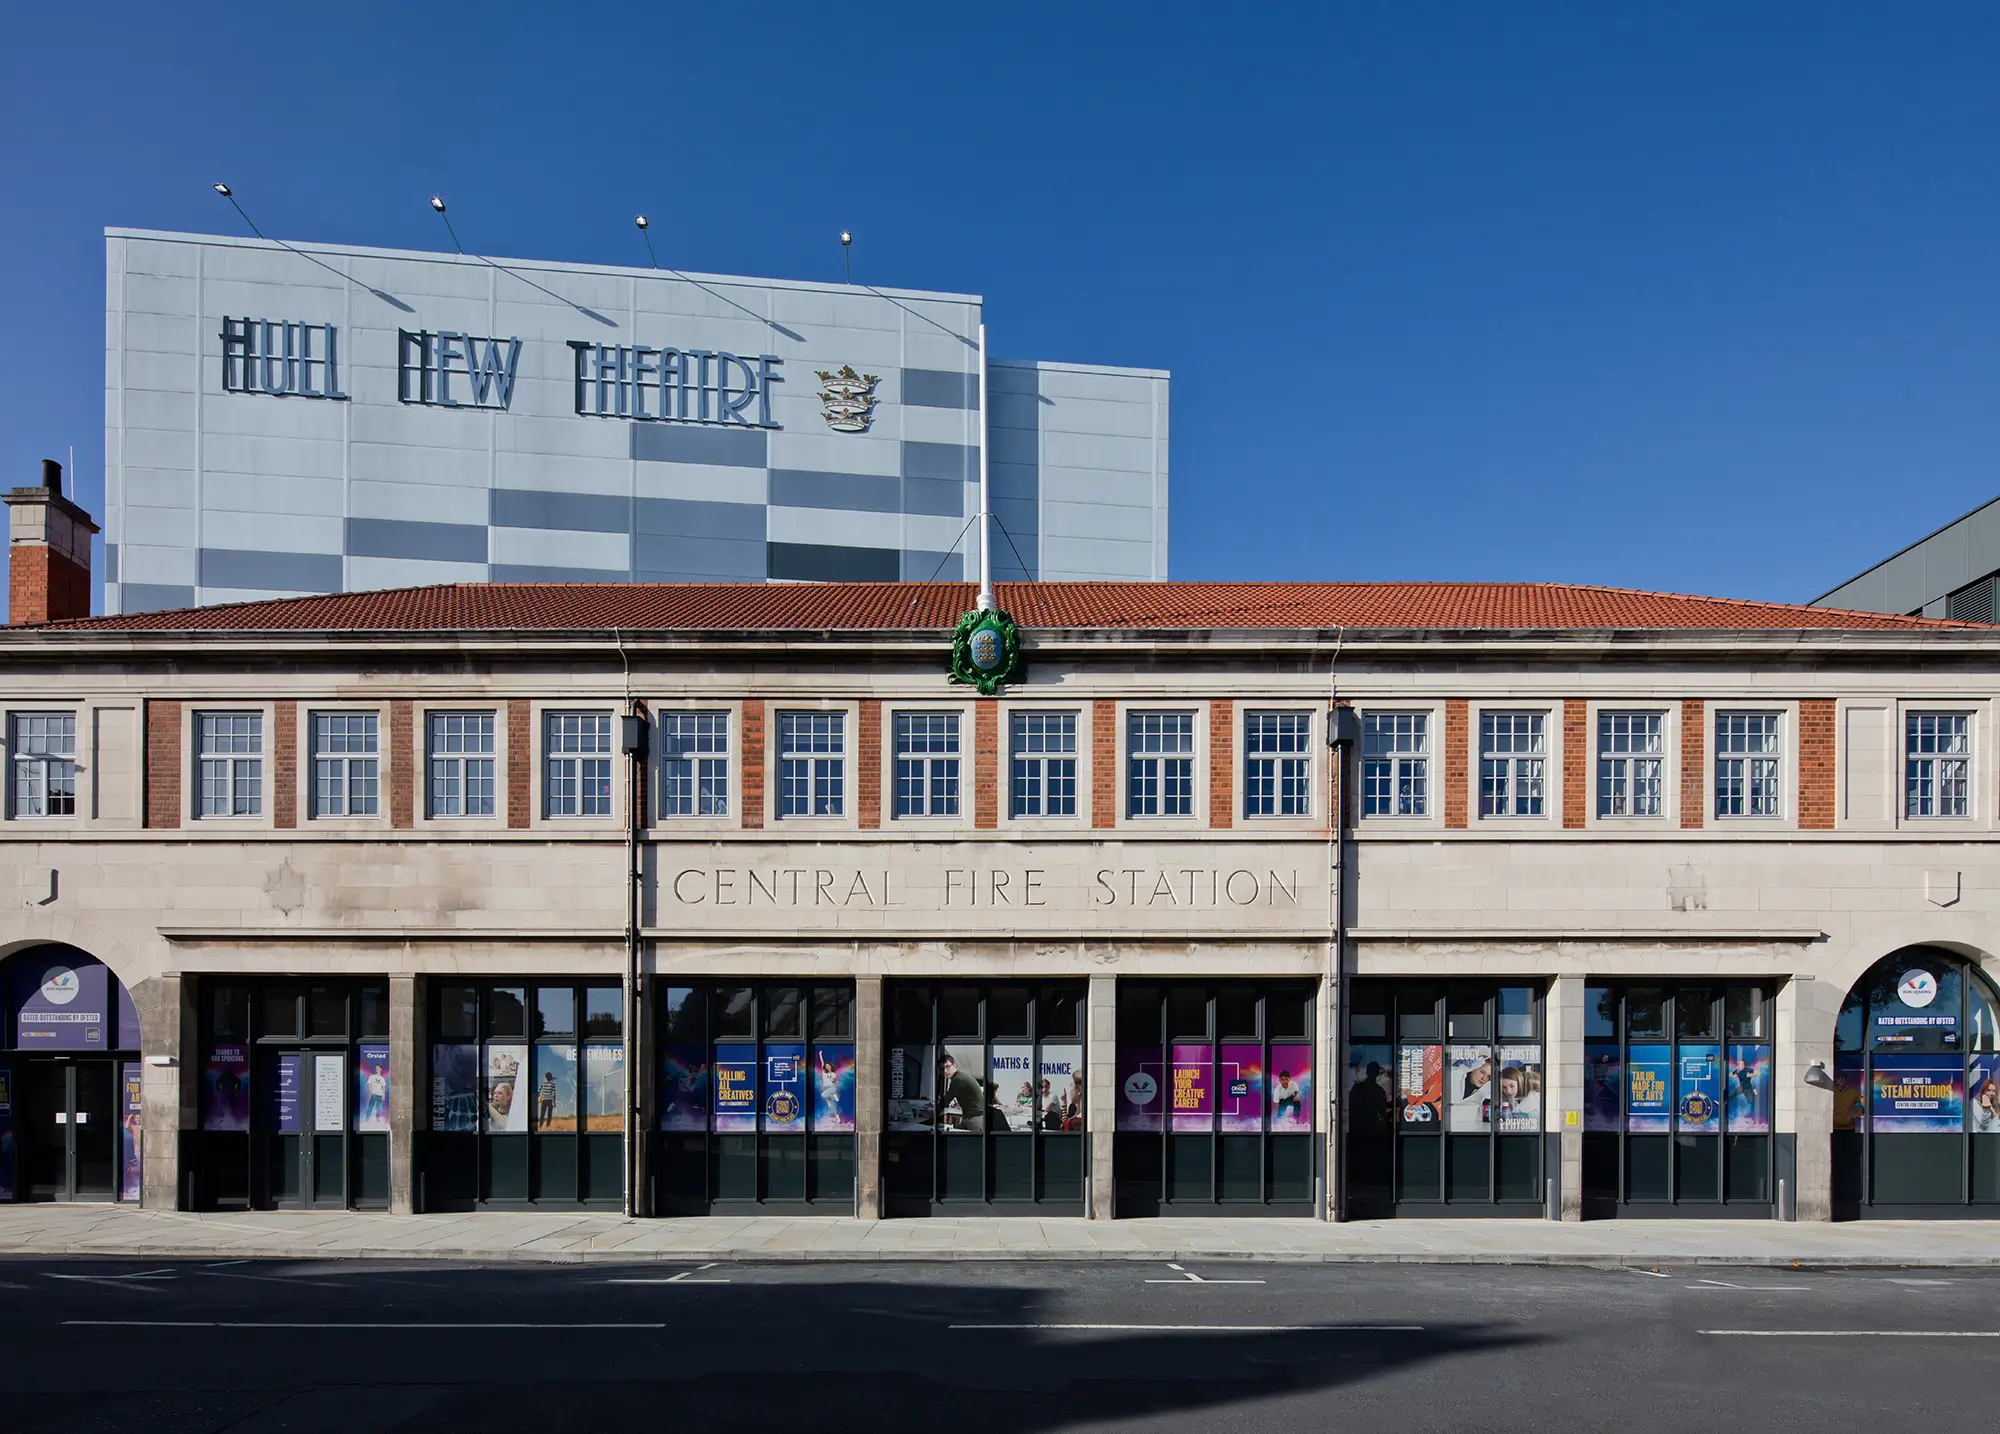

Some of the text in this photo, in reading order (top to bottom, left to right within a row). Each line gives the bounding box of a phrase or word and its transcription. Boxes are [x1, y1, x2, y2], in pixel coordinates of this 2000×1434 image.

[218, 315, 783, 430] HULL NEW THEATRE
[673, 868, 1300, 906] CENTRAL FIRE STATION
[1878, 1017, 1955, 1025] RATED OUTSTANDING BY OFSTED
[566, 1048, 623, 1061] RENEWABLES
[1498, 1048, 1540, 1060] CHEMISTRY
[993, 1057, 1030, 1070] MATHS &
[1039, 1062, 1072, 1075] FINANCE
[718, 1070, 746, 1081] CALLING
[892, 1048, 904, 1099] ENGINEERING
[1174, 1068, 1200, 1080] LAUNCH
[1398, 1057, 1410, 1089] DIGITAL
[1411, 1049, 1424, 1097] COMPUTING
[1632, 1072, 1655, 1080] TAILOR
[126, 1083, 139, 1093] FOR
[718, 1080, 730, 1090] ALL
[1174, 1079, 1192, 1089] YOUR
[1632, 1081, 1664, 1090] MADE FOR
[432, 1077, 445, 1106] DESIGN
[718, 1090, 754, 1100] CREATIVES
[1174, 1088, 1204, 1098] CREATIVE
[1632, 1090, 1664, 1100] THE ARTS
[1881, 1085, 1952, 1098] STEAM STUDIOS
[1174, 1098, 1198, 1108] CAREER
[432, 1115, 445, 1132] ART
[1505, 1118, 1538, 1130] PHYSICS
